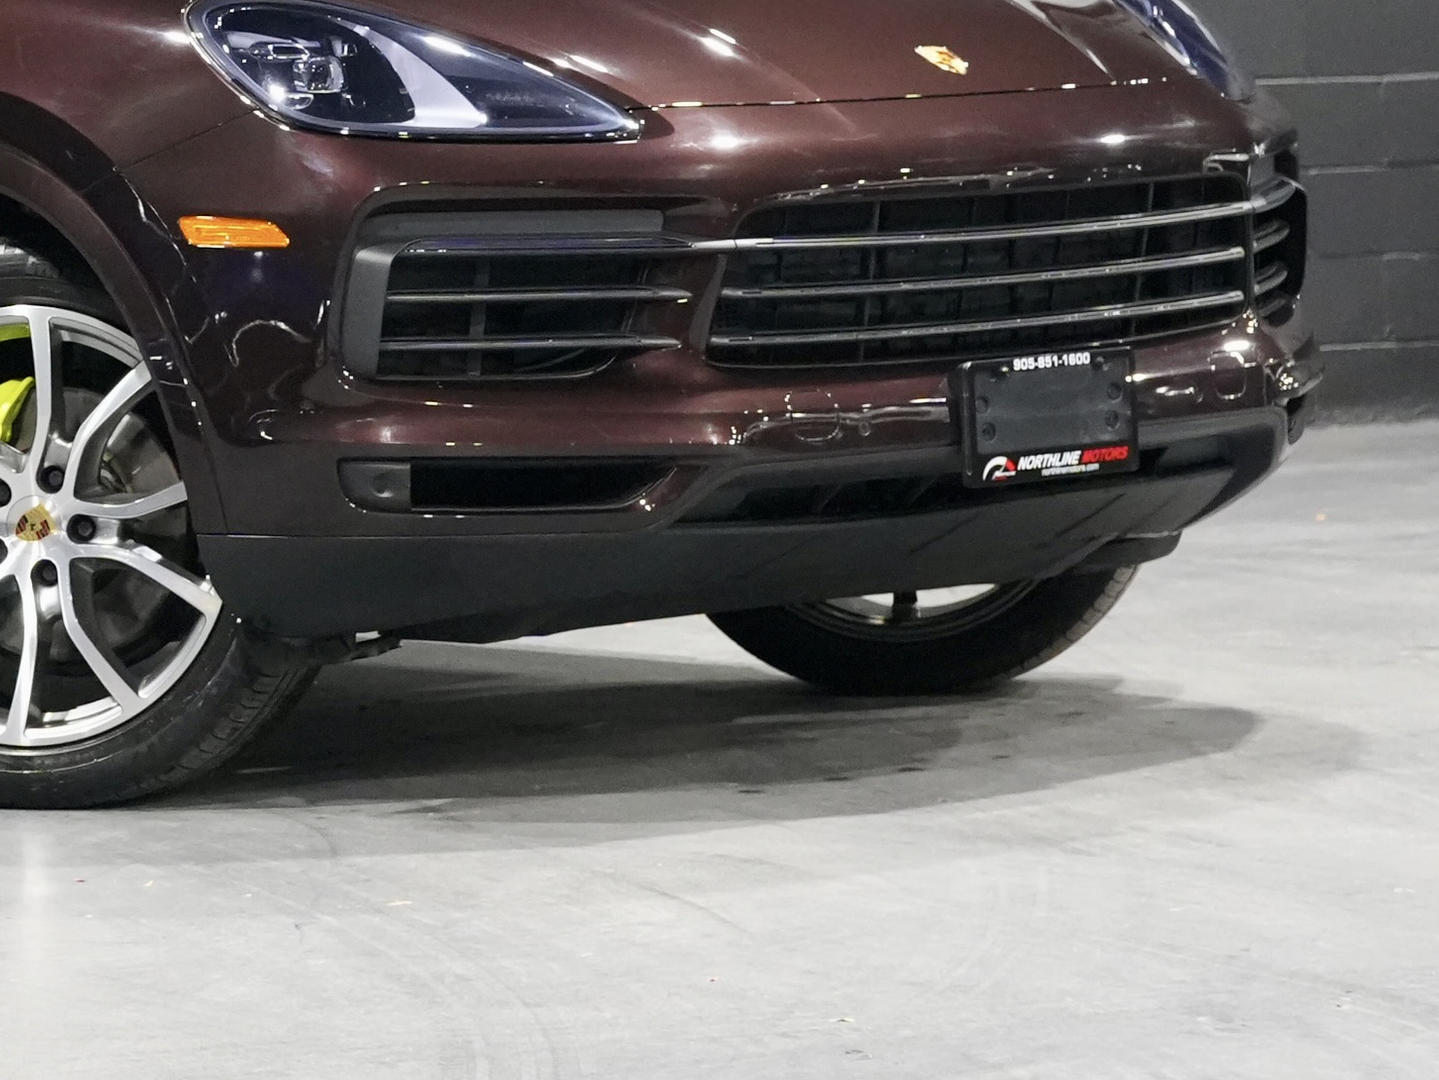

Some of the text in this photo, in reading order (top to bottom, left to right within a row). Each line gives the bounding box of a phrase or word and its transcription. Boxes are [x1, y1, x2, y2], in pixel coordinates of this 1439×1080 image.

[1013, 351, 1091, 372] 905-851-1600
[1017, 445, 1129, 471] NORTHLINE MOTORS
